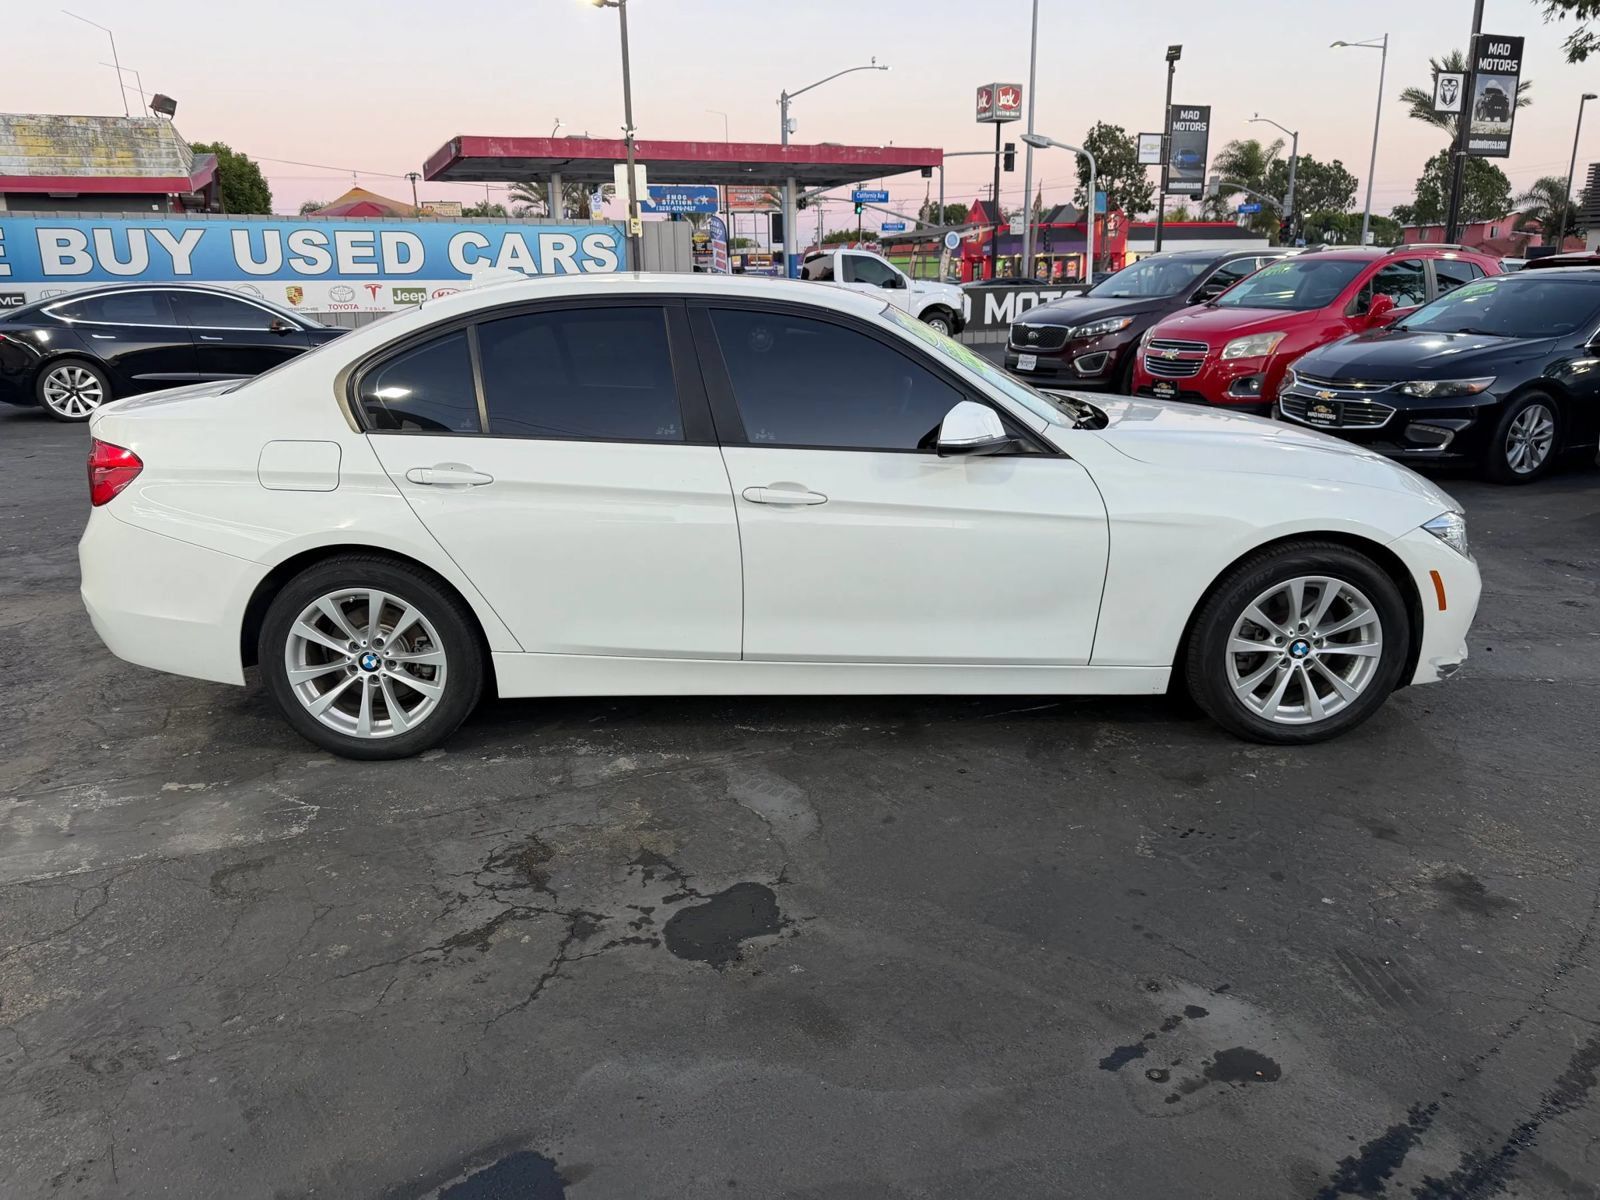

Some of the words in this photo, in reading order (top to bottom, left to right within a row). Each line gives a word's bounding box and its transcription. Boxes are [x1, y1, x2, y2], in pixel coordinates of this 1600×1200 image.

[1488, 42, 1511, 56] MAD
[1478, 57, 1519, 72] MOTORS
[1180, 110, 1200, 120] MAD
[1172, 121, 1207, 131] MOTORS
[35, 227, 207, 276] BUY
[230, 229, 426, 275] USED
[447, 230, 619, 275] CARS
[0, 296, 24, 306] MC
[393, 289, 427, 303] Jeep
[328, 303, 359, 311] TOYOTA
